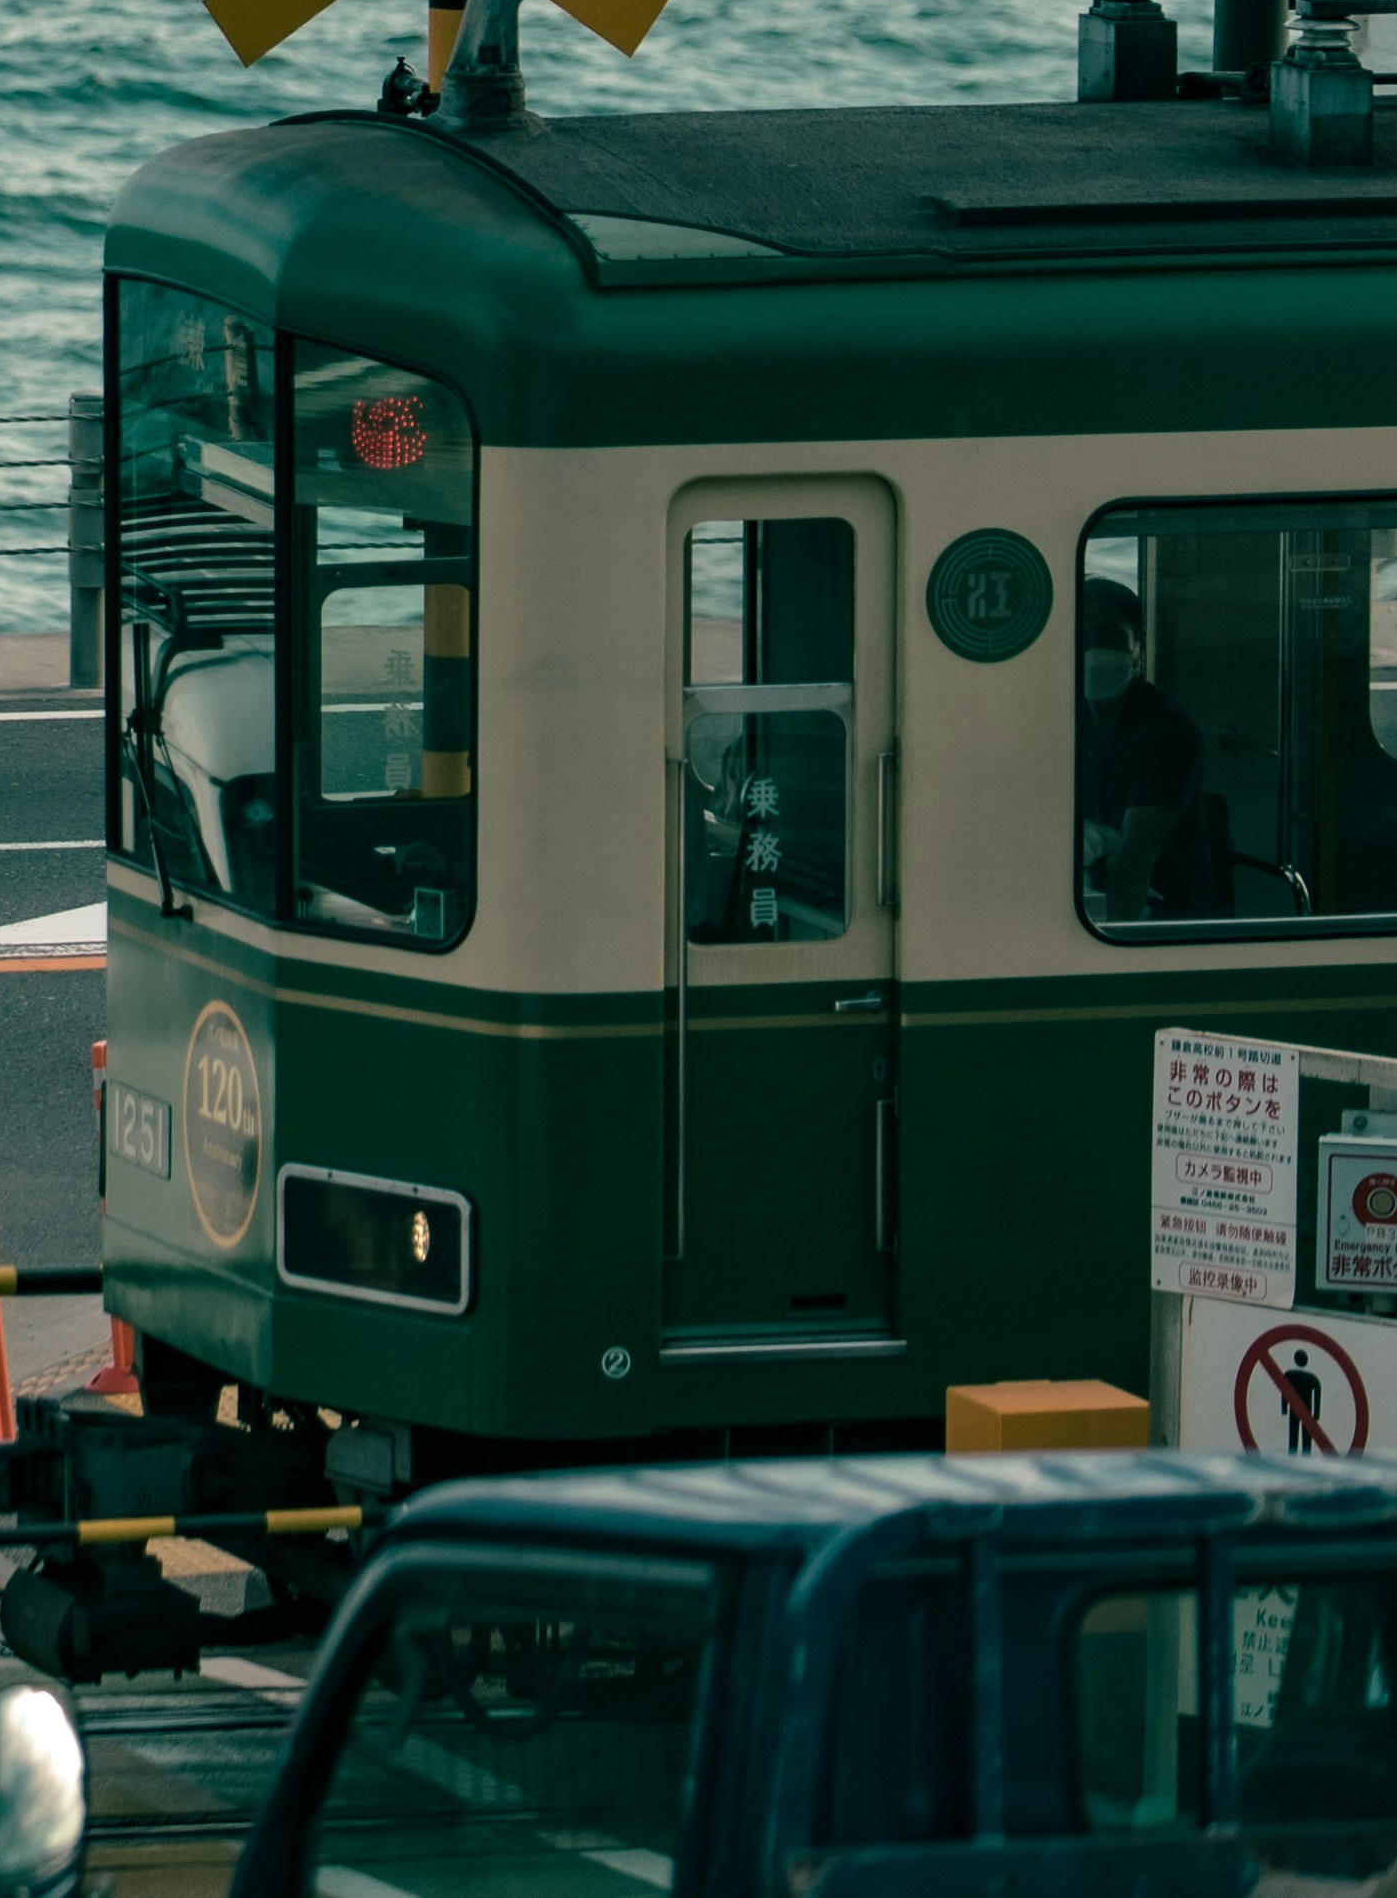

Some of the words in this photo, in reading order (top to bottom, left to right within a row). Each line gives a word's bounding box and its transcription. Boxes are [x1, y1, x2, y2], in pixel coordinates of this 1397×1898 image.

[746, 777, 782, 929] 乗務員
[1169, 1059, 1279, 1094] 非常の際は
[1168, 1086, 1281, 1120] このボタンを
[113, 1090, 164, 1169] 1251
[1185, 1160, 1263, 1187] カメラ監視中
[1334, 1239, 1391, 1255] Emergency
[1366, 1226, 1397, 1241] PB3
[1189, 1267, 1258, 1294] 监控录像中
[1256, 1608, 1292, 1628] Kee
